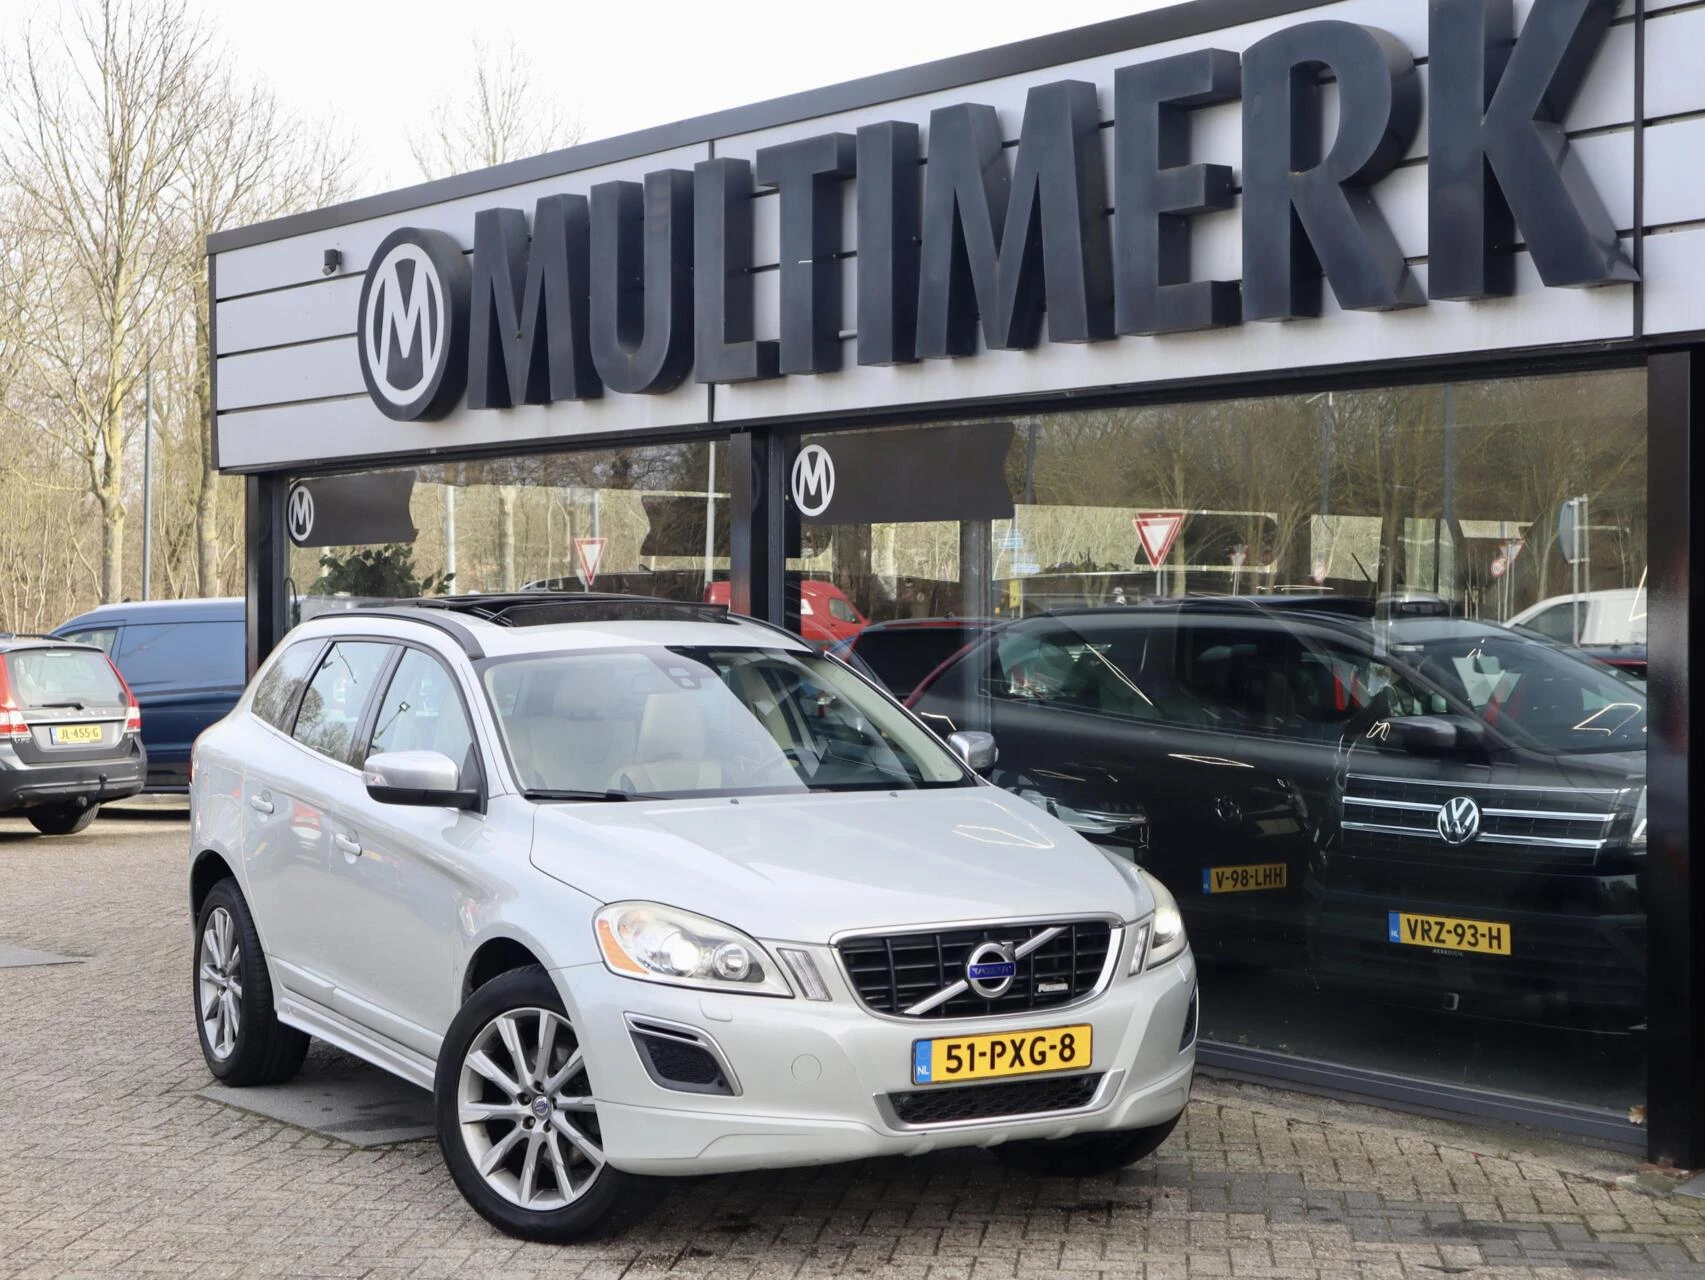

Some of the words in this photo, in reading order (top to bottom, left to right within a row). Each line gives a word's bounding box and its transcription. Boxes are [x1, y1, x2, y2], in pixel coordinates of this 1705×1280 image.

[468, 0, 1639, 409] MULTIMERK
[1216, 868, 1282, 889] V-98-LHH
[1407, 919, 1502, 950] VRZ-93-H
[917, 1066, 929, 1075] NL
[946, 1033, 1075, 1073] 51-PXG-8
